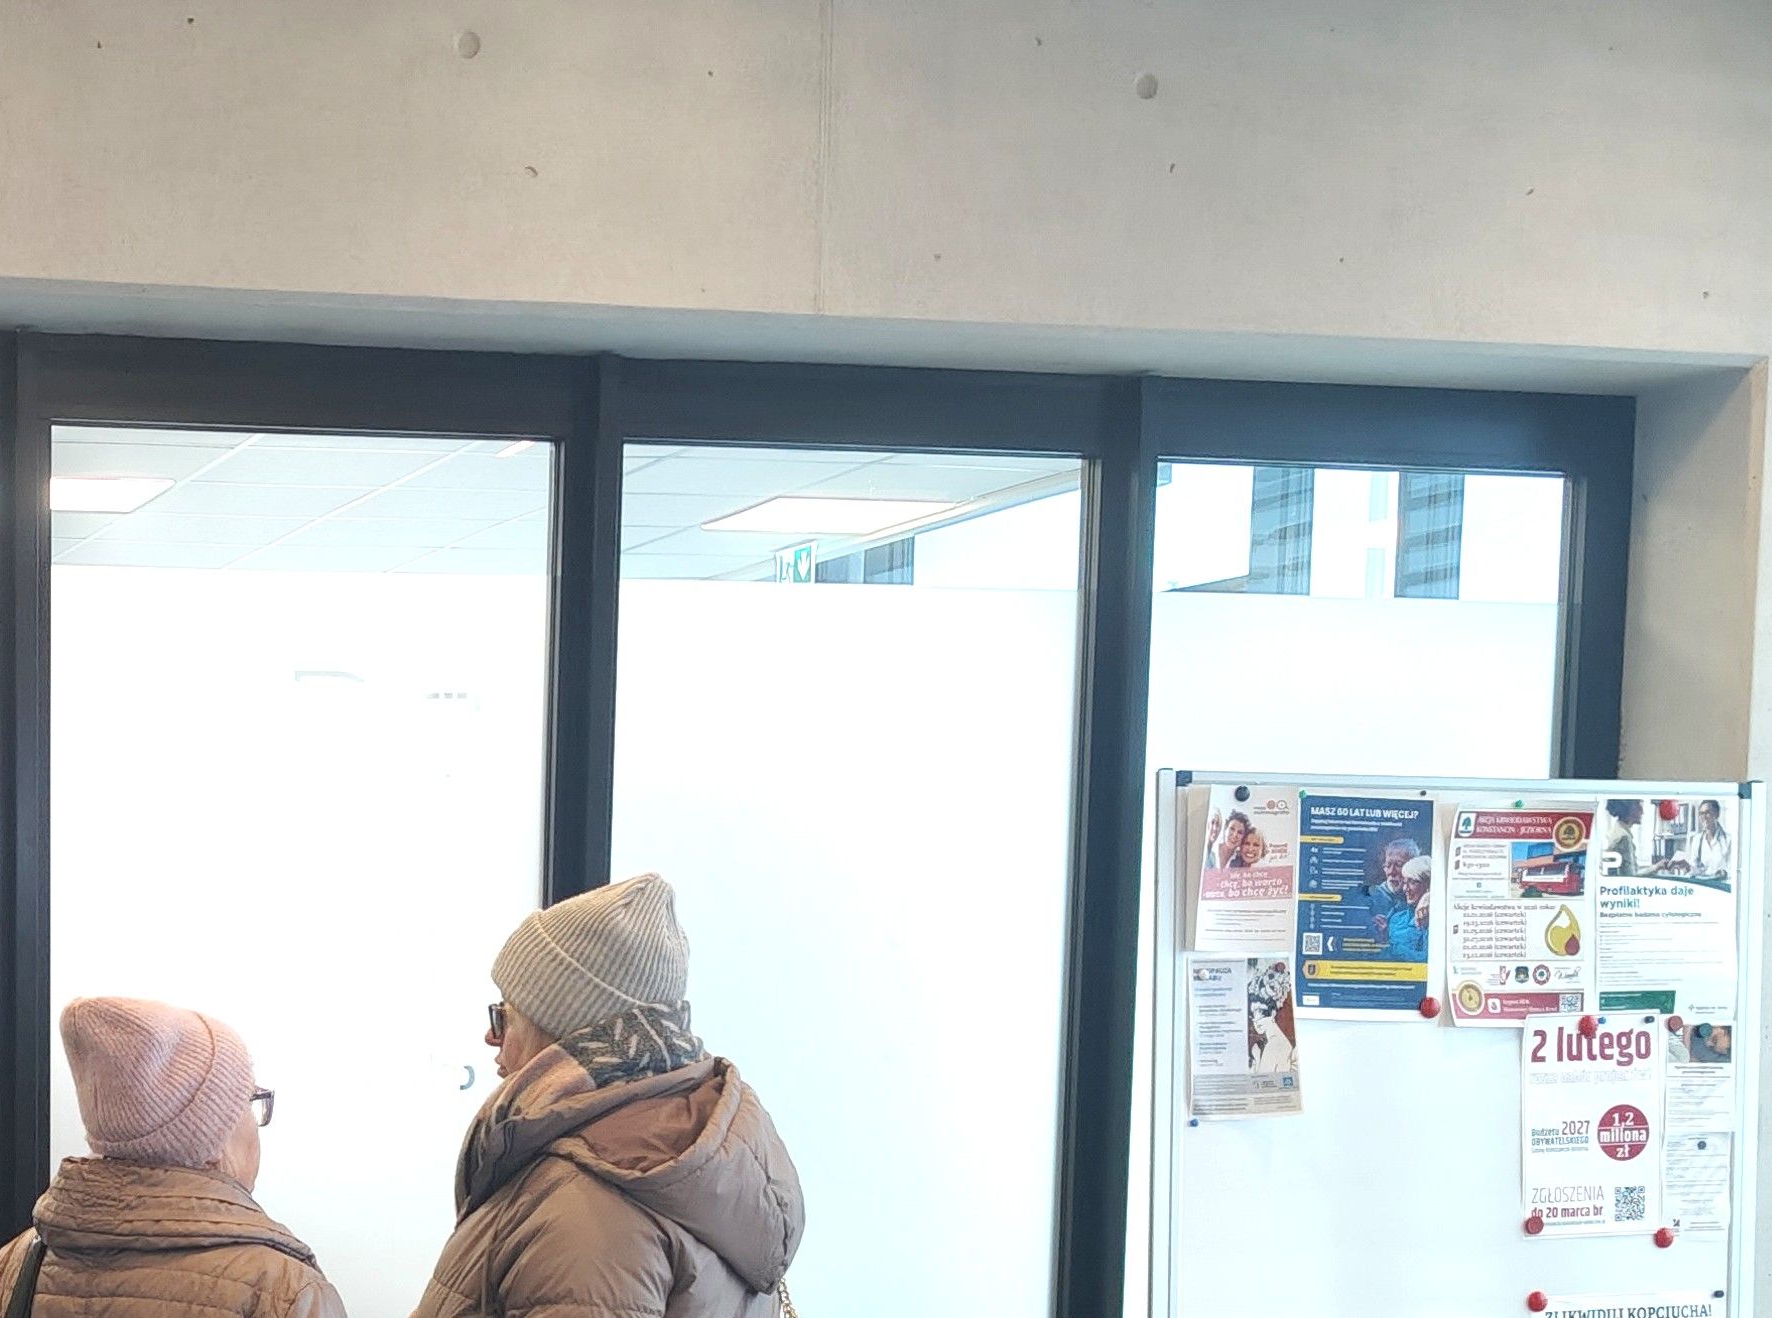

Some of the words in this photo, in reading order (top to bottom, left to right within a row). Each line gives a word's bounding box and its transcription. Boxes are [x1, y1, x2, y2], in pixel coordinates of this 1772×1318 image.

[1310, 807, 1336, 816] MASZ
[1349, 808, 1364, 817] LAT
[1365, 809, 1381, 818] LUB
[1383, 810, 1419, 820] WIĘCEJ?
[1599, 886, 1667, 897] Profilaktyka
[1671, 885, 1694, 897] daje
[1600, 898, 1640, 910] wyniki!
[1531, 1029, 1547, 1063] 2
[1557, 1027, 1651, 1067] lutego
[1612, 1112, 1635, 1128] 1,2
[1562, 1120, 1590, 1135] 2027
[1599, 1127, 1647, 1142] miliona
[1531, 1136, 1589, 1146] OBYWATELSKIEGO
[1616, 1144, 1630, 1158] zł
[1531, 1185, 1604, 1204] ZGŁOSZENIA
[1531, 1207, 1543, 1218] do
[1546, 1206, 1558, 1218] 20
[1561, 1206, 1590, 1218] marca
[1593, 1204, 1603, 1216] br
